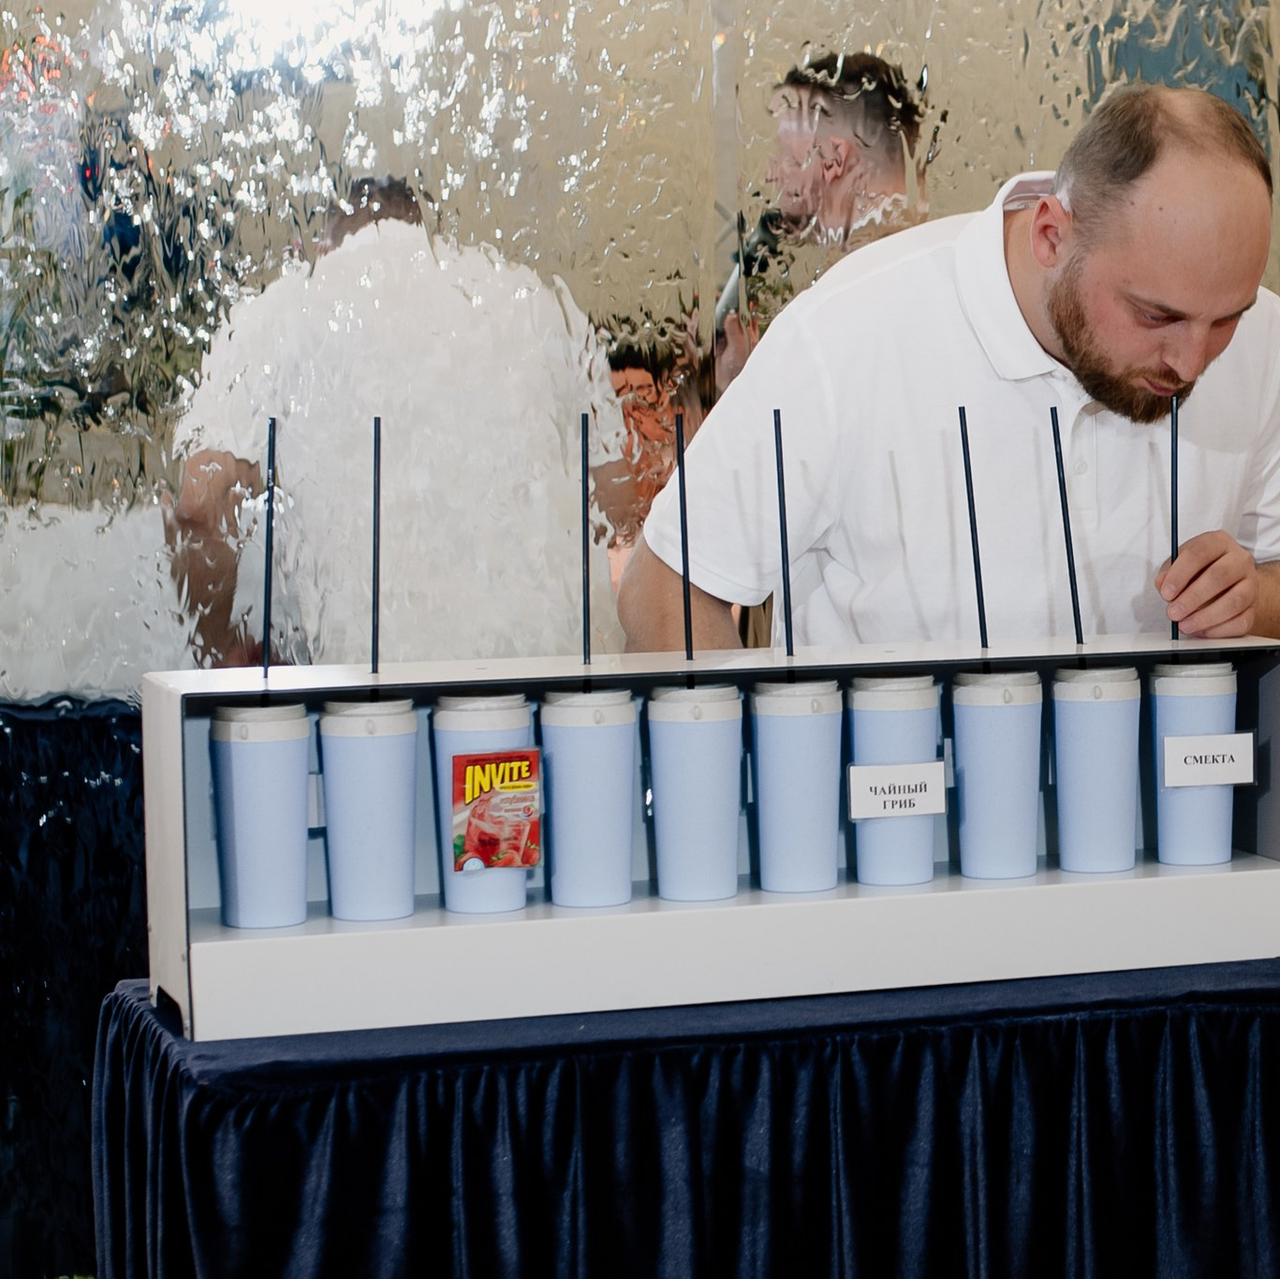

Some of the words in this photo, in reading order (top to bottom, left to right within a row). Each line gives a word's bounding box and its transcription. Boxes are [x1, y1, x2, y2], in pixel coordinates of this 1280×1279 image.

[1183, 754, 1236, 765] СМЕКТА
[465, 761, 531, 805] INVITE
[869, 781, 928, 796] ЧАЙНЫЙ
[883, 798, 916, 810] ГРИБ
